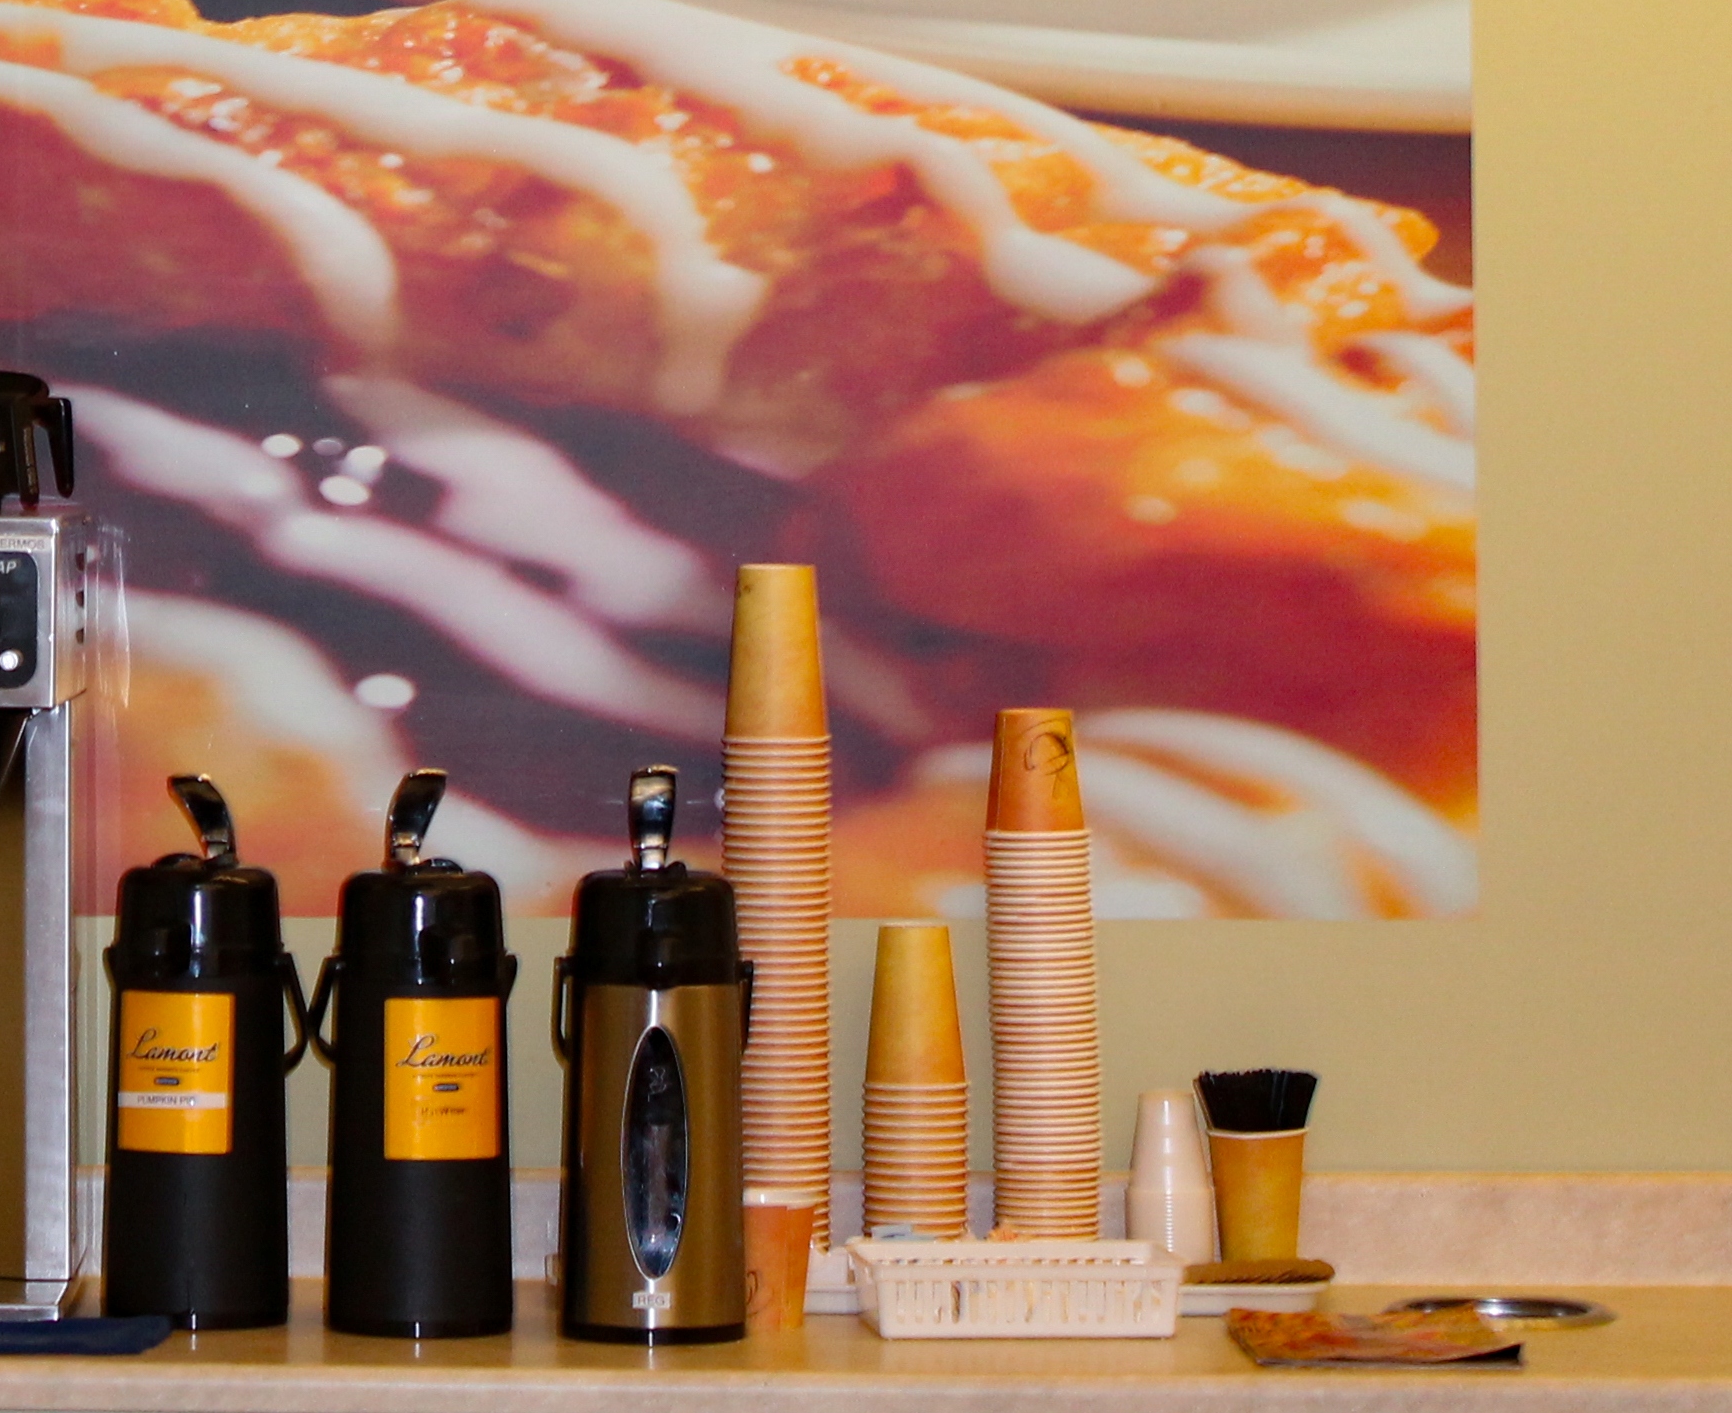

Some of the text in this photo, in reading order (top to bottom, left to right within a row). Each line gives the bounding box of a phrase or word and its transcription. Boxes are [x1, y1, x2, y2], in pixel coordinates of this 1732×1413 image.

[127, 1028, 219, 1062] Lamont
[395, 1034, 488, 1068] Lamont
[137, 1095, 177, 1105] PUMPKIN
[638, 1295, 665, 1306] REG
